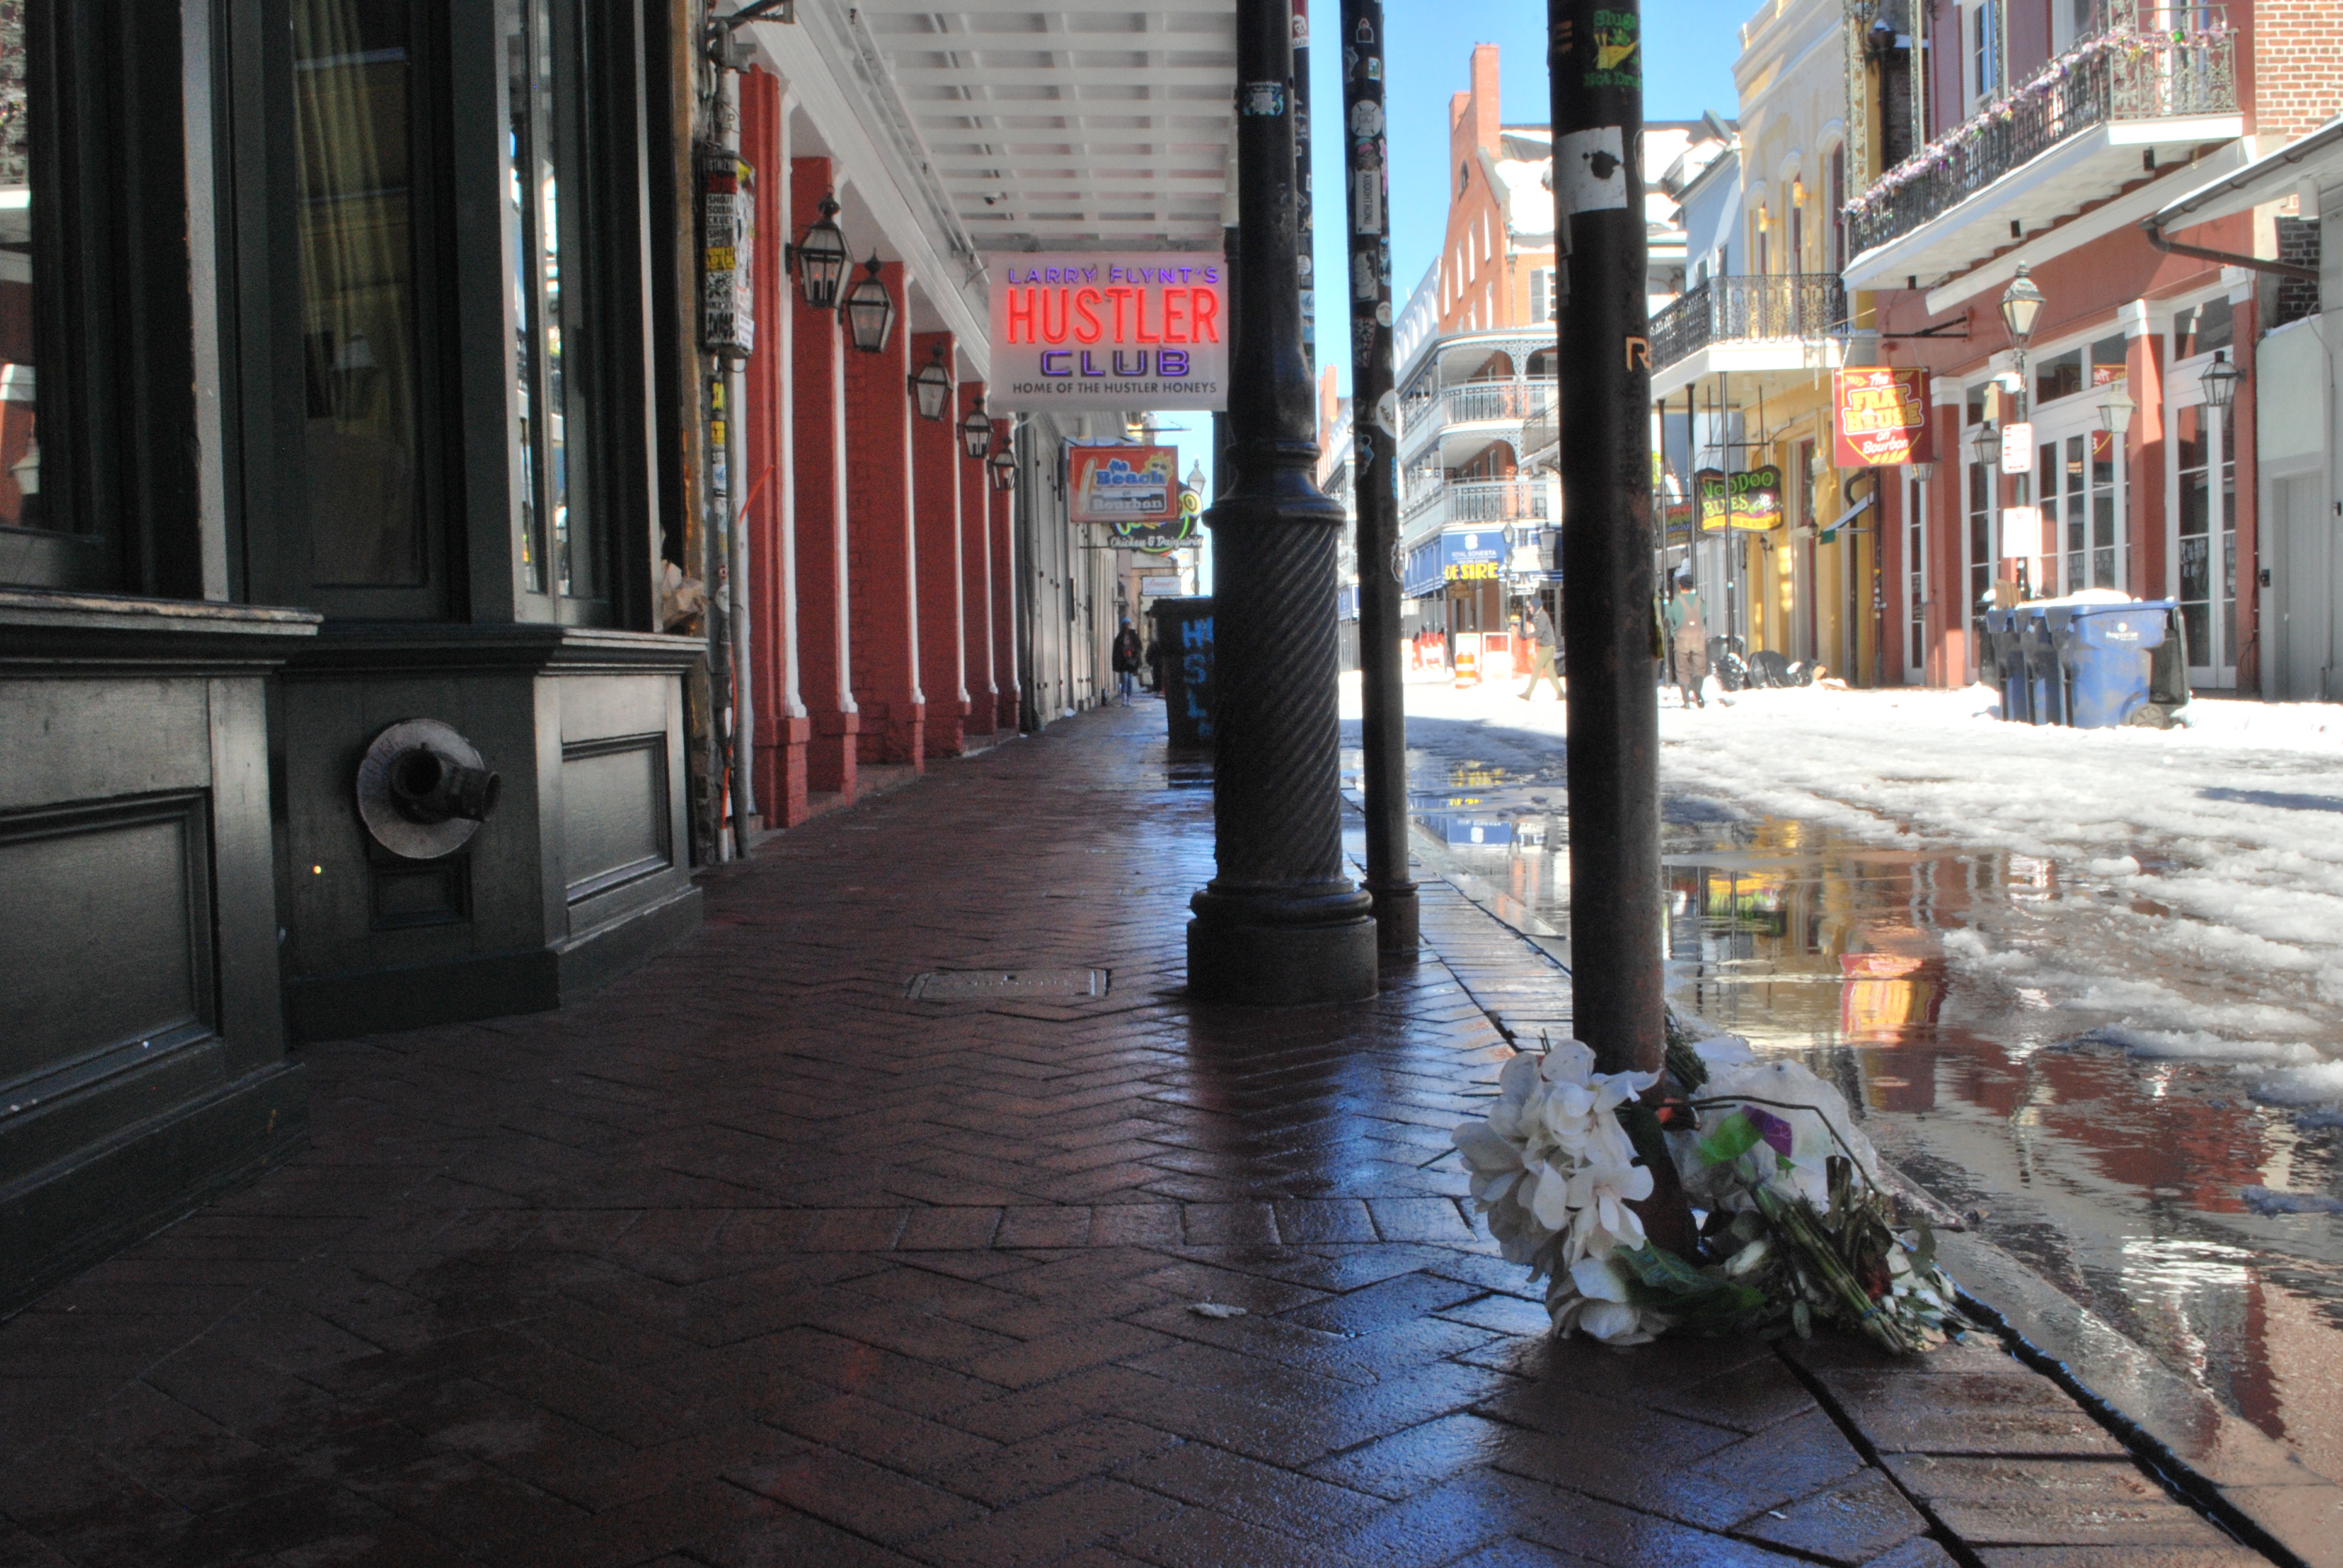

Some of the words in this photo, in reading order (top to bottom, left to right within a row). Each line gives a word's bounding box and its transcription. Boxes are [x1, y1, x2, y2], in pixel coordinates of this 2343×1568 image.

[1008, 267, 1096, 284] LARRY
[1110, 266, 1219, 284] FLYNT'S
[1008, 286, 1219, 344] HUSTLER
[1040, 349, 1190, 377] CLUB
[1869, 372, 1889, 386] The
[1013, 382, 1052, 394] HOME
[1057, 382, 1072, 393] OF
[1077, 382, 1100, 393] THE
[1104, 382, 1158, 393] HUSTLER
[1162, 382, 1217, 393] HONEYS
[1851, 387, 1909, 411] FRAT
[1876, 431, 1890, 442] on
[1863, 436, 1909, 454] Bourbon
[1096, 470, 1166, 485] Beach
[1093, 498, 1163, 510] Bourbon
[1110, 536, 1147, 548] Chicken
[1148, 536, 1155, 546] &
